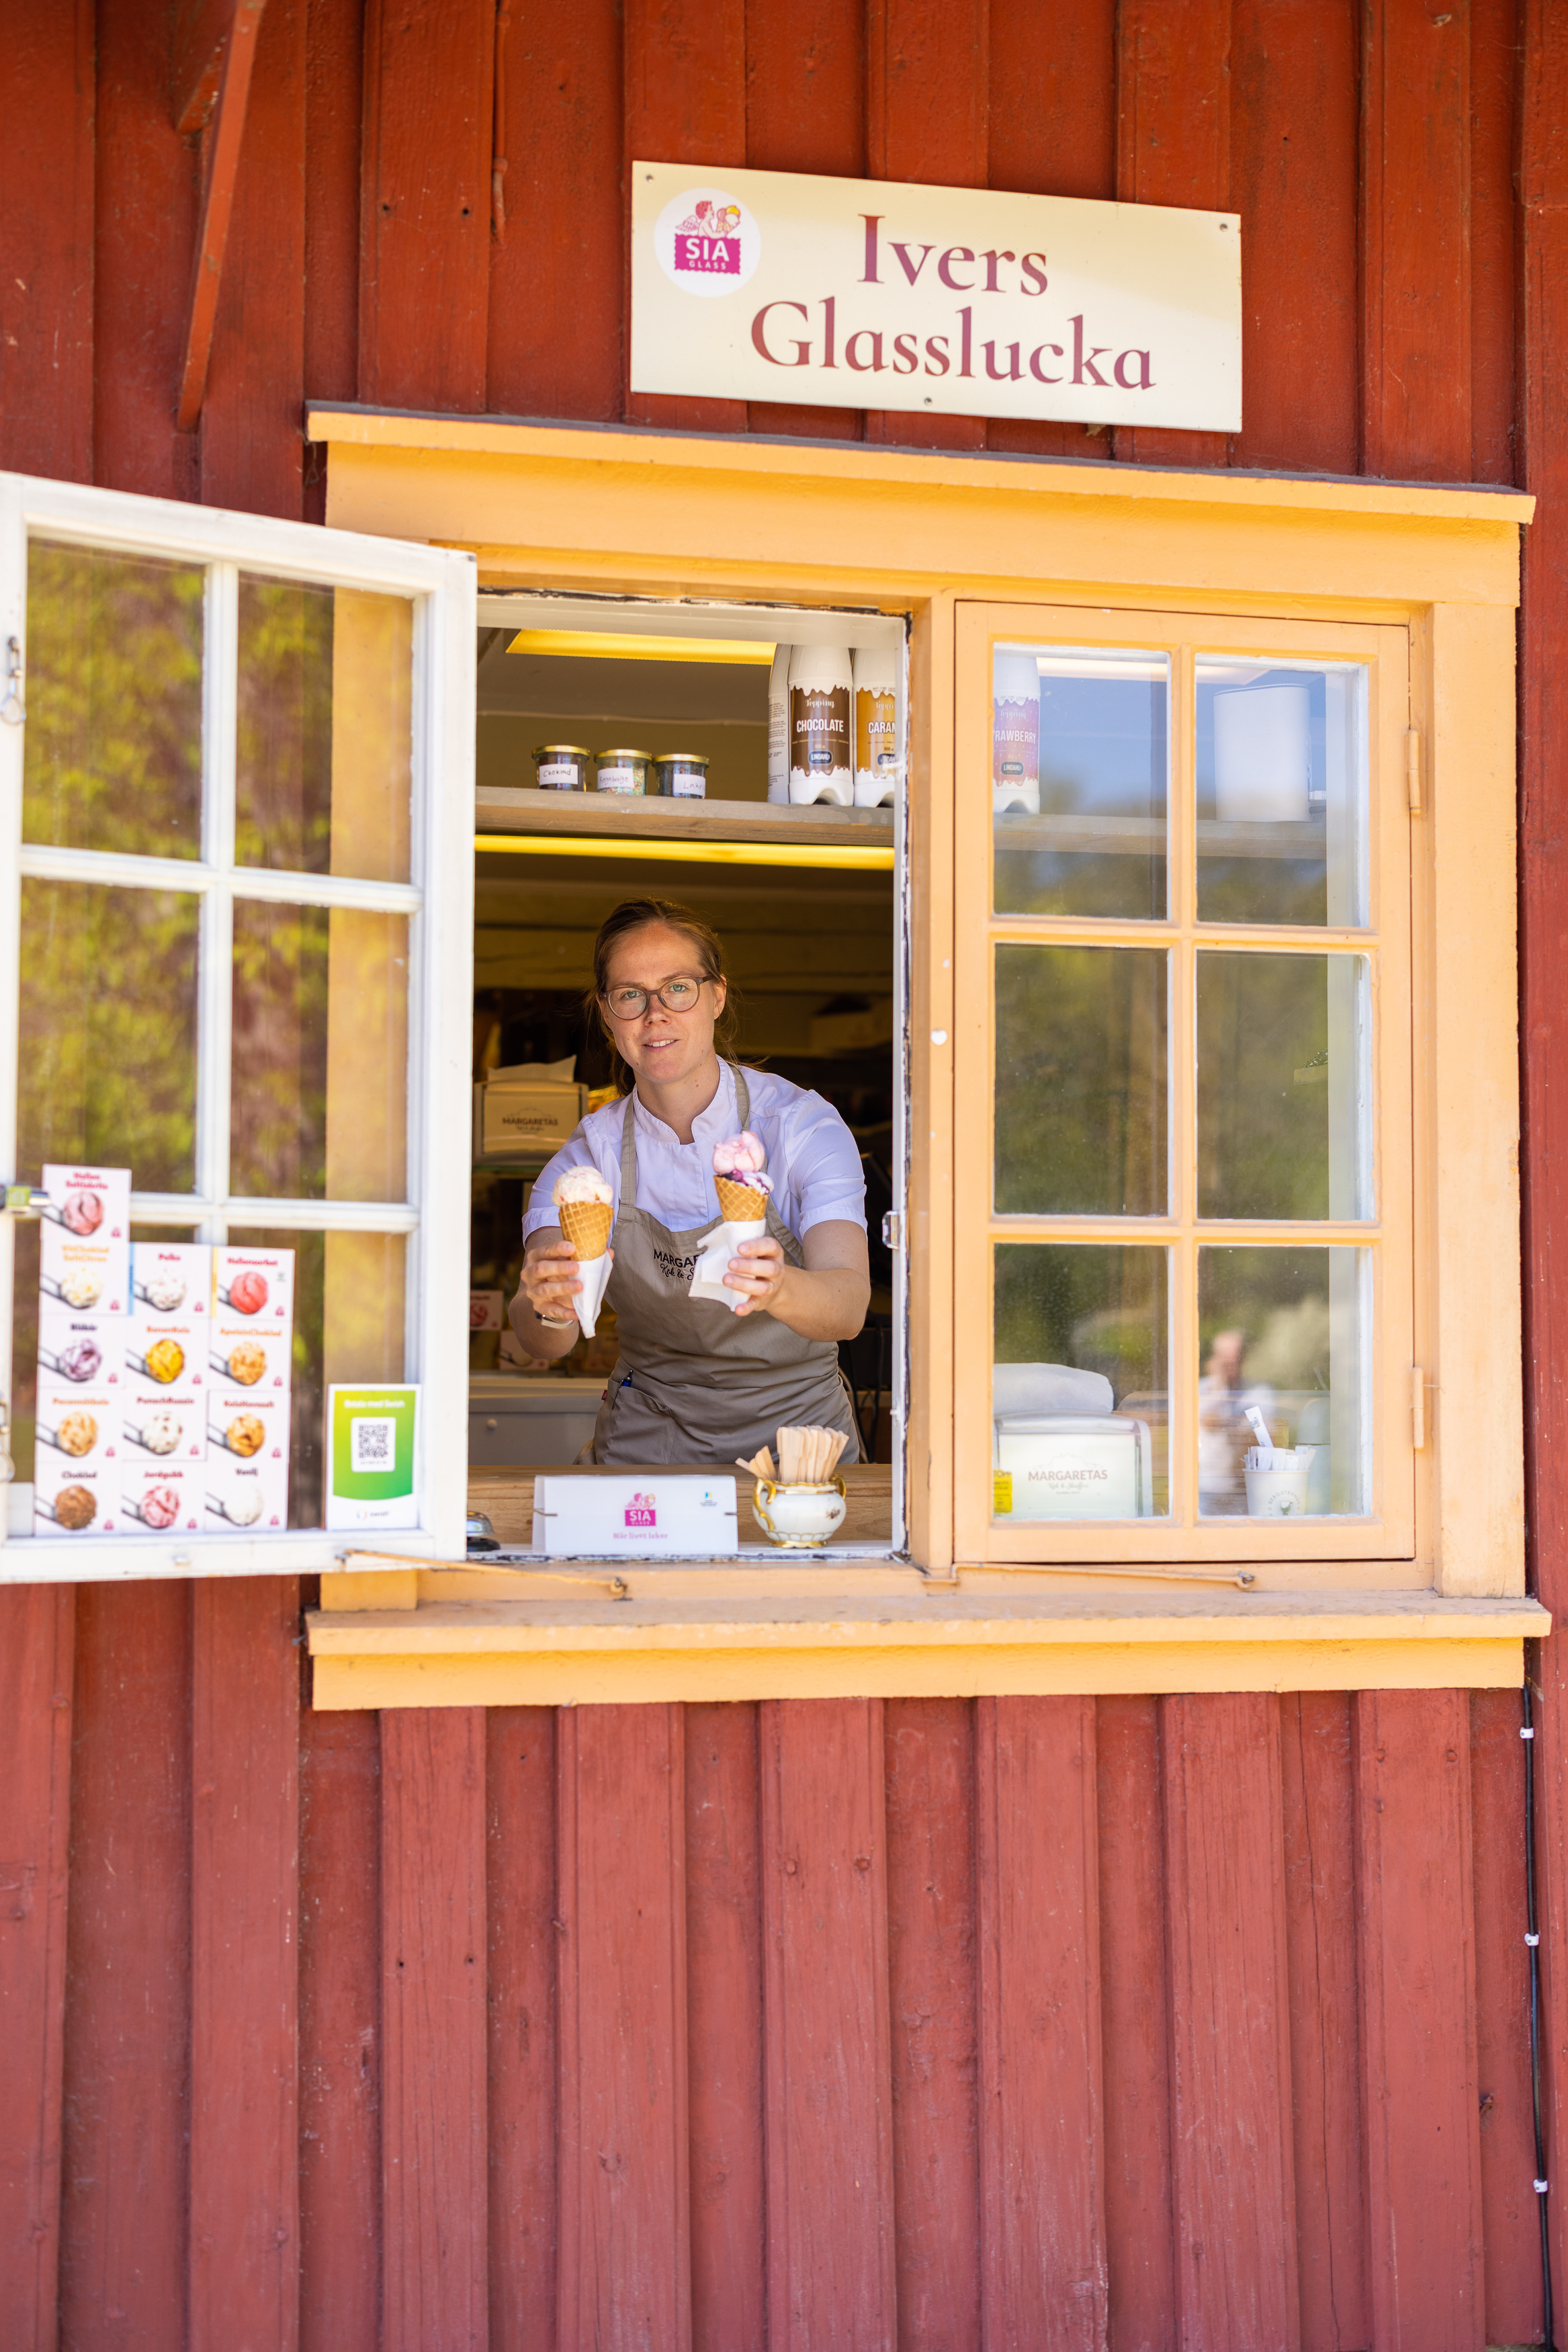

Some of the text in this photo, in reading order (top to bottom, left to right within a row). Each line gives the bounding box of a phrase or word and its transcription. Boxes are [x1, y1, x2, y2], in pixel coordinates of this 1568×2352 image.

[686, 237, 730, 261] SIA
[858, 213, 1049, 296] Ivers
[689, 260, 726, 270] GLASS
[750, 296, 1157, 391] Glasslucka
[797, 718, 844, 733] CHOCOLATE
[993, 730, 1037, 744] RAWBERRY
[502, 1117, 559, 1126] MARGARETAS
[1028, 1469, 1108, 1481] MARGARETAS
[629, 1510, 652, 1521] SIA
